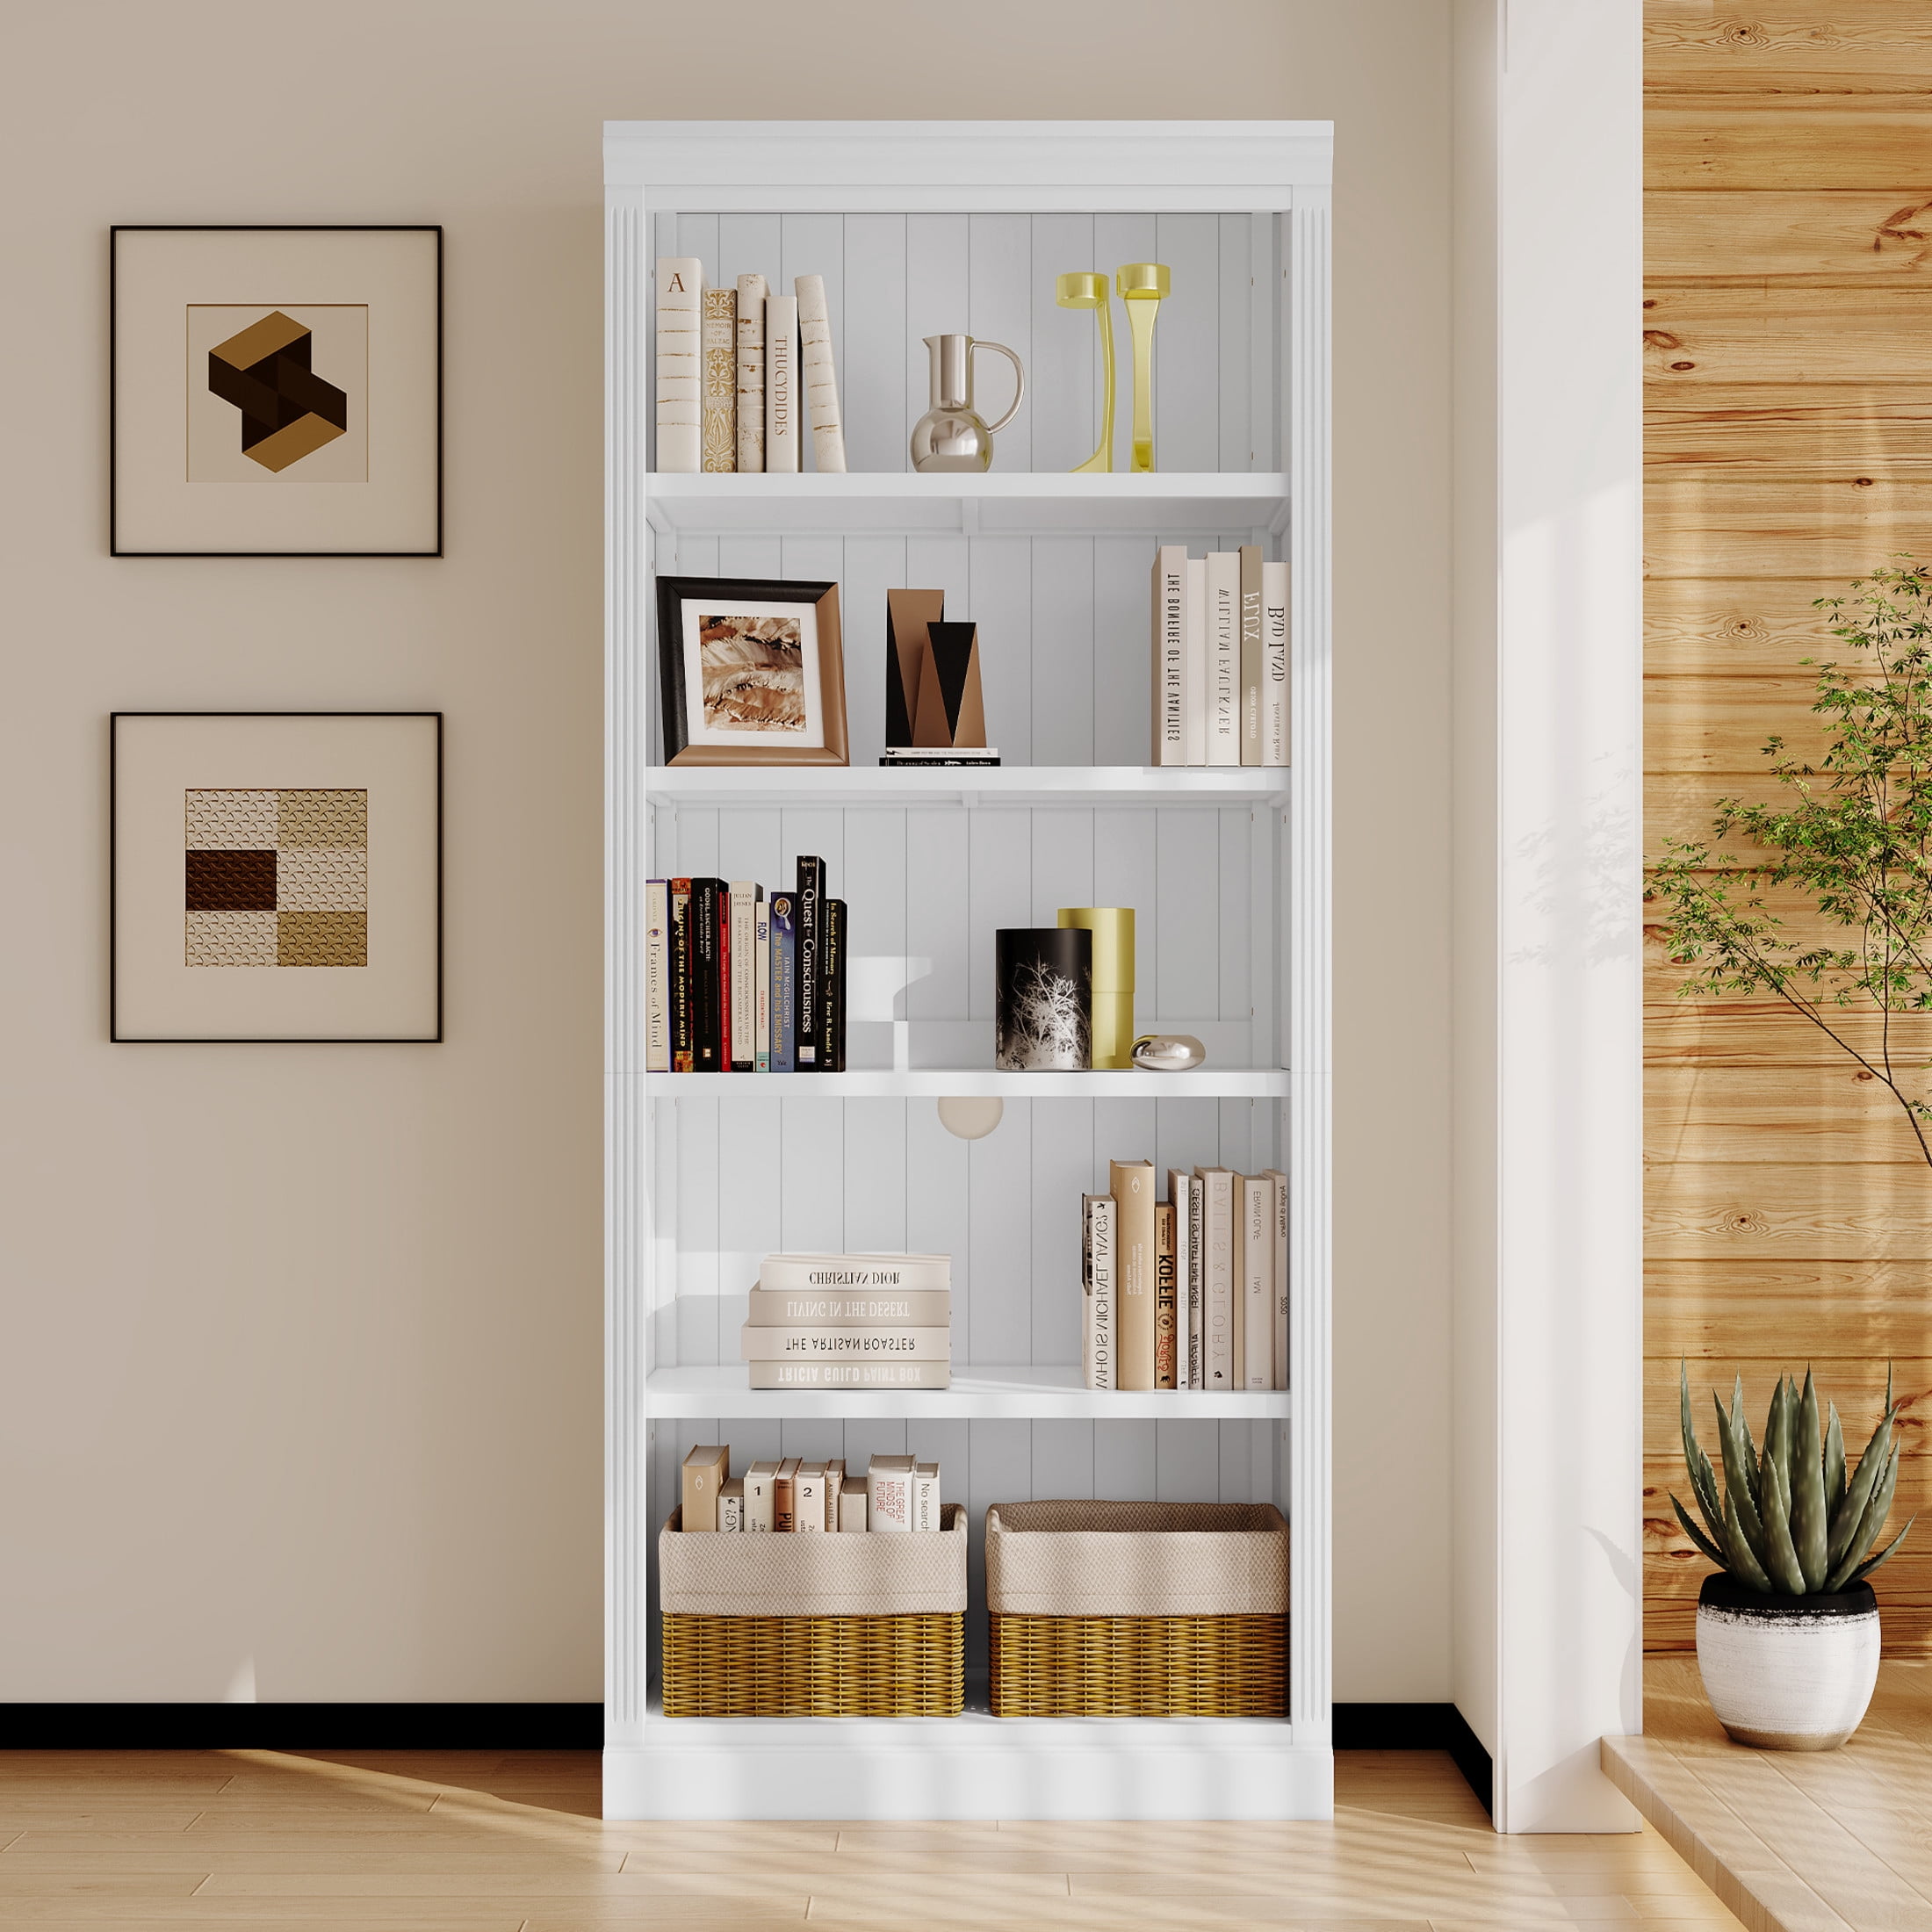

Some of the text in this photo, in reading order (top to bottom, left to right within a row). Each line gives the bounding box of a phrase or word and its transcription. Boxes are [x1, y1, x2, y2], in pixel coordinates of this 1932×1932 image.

[667, 273, 687, 292] A
[775, 335, 788, 436] THUCYDIDES
[802, 889, 815, 928] Quest
[758, 922, 767, 941] FLOW
[678, 941, 684, 950] OF
[831, 937, 836, 946] of
[650, 943, 660, 993] Frames
[774, 932, 782, 1054] The MASTER and his EMISSARY
[803, 939, 815, 1033] Consciousness
[651, 997, 660, 1009] of
[651, 1013, 661, 1049] Mind
[826, 1018, 833, 1027] R.
[754, 1486, 761, 1496] 1
[803, 1488, 812, 1497] 2
[877, 1481, 886, 1512] FUTURE
[921, 1483, 930, 1498] No
[897, 1481, 905, 1525] THE GREAT
[887, 1508, 895, 1518] OF
